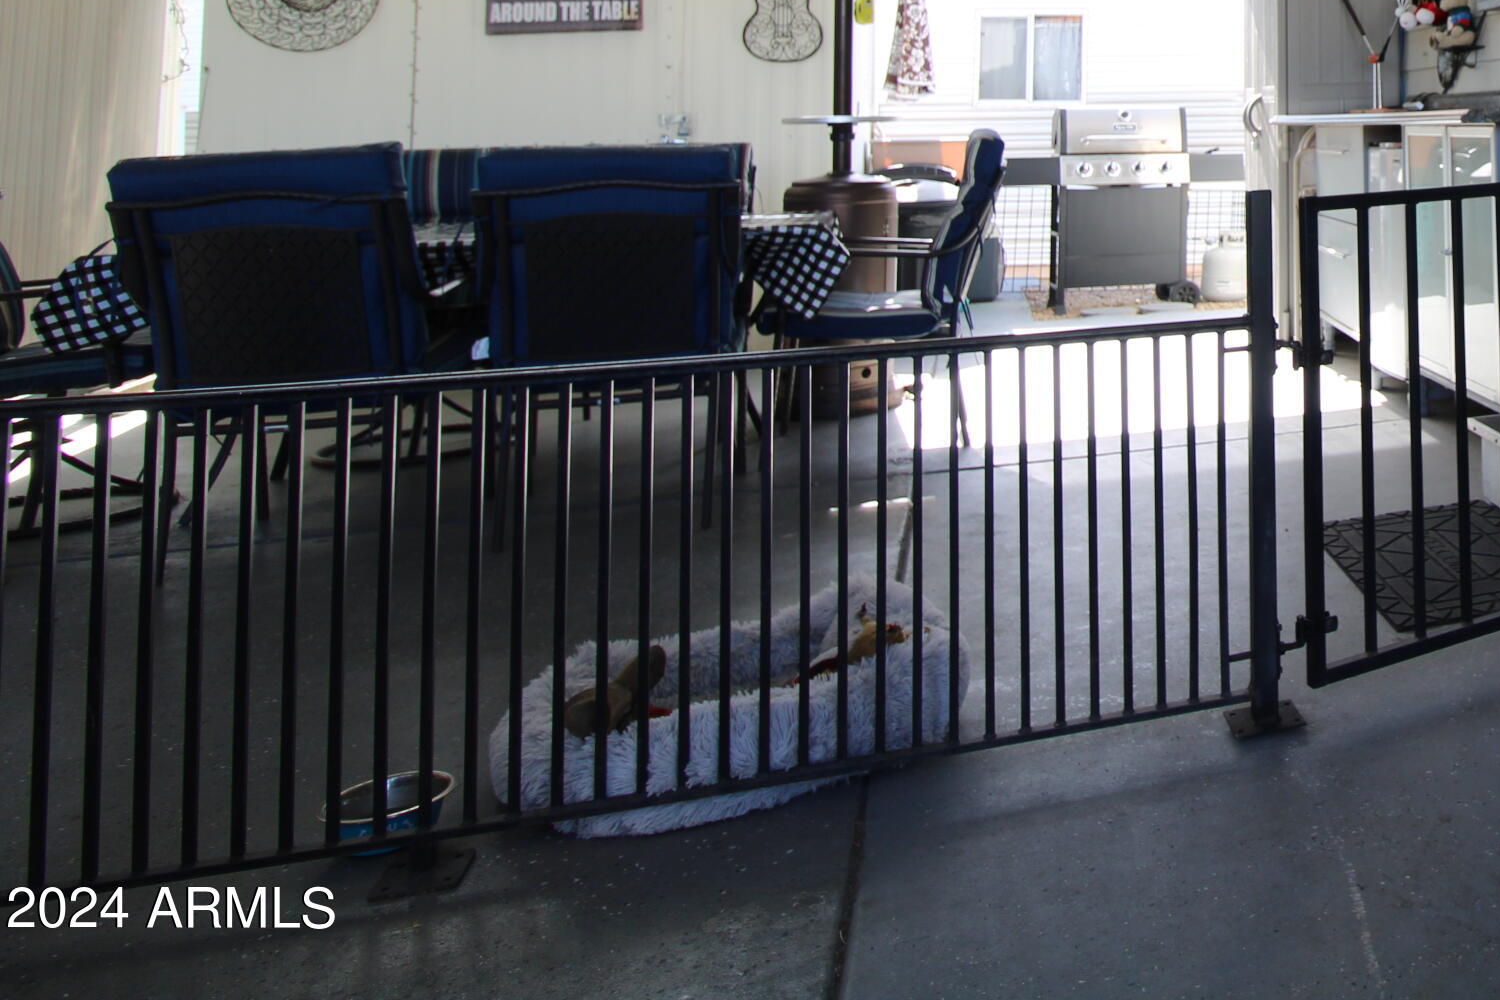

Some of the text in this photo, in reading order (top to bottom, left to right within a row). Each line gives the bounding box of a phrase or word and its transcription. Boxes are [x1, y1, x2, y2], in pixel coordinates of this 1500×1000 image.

[490, 0, 639, 23] AROUND THE TABLE
